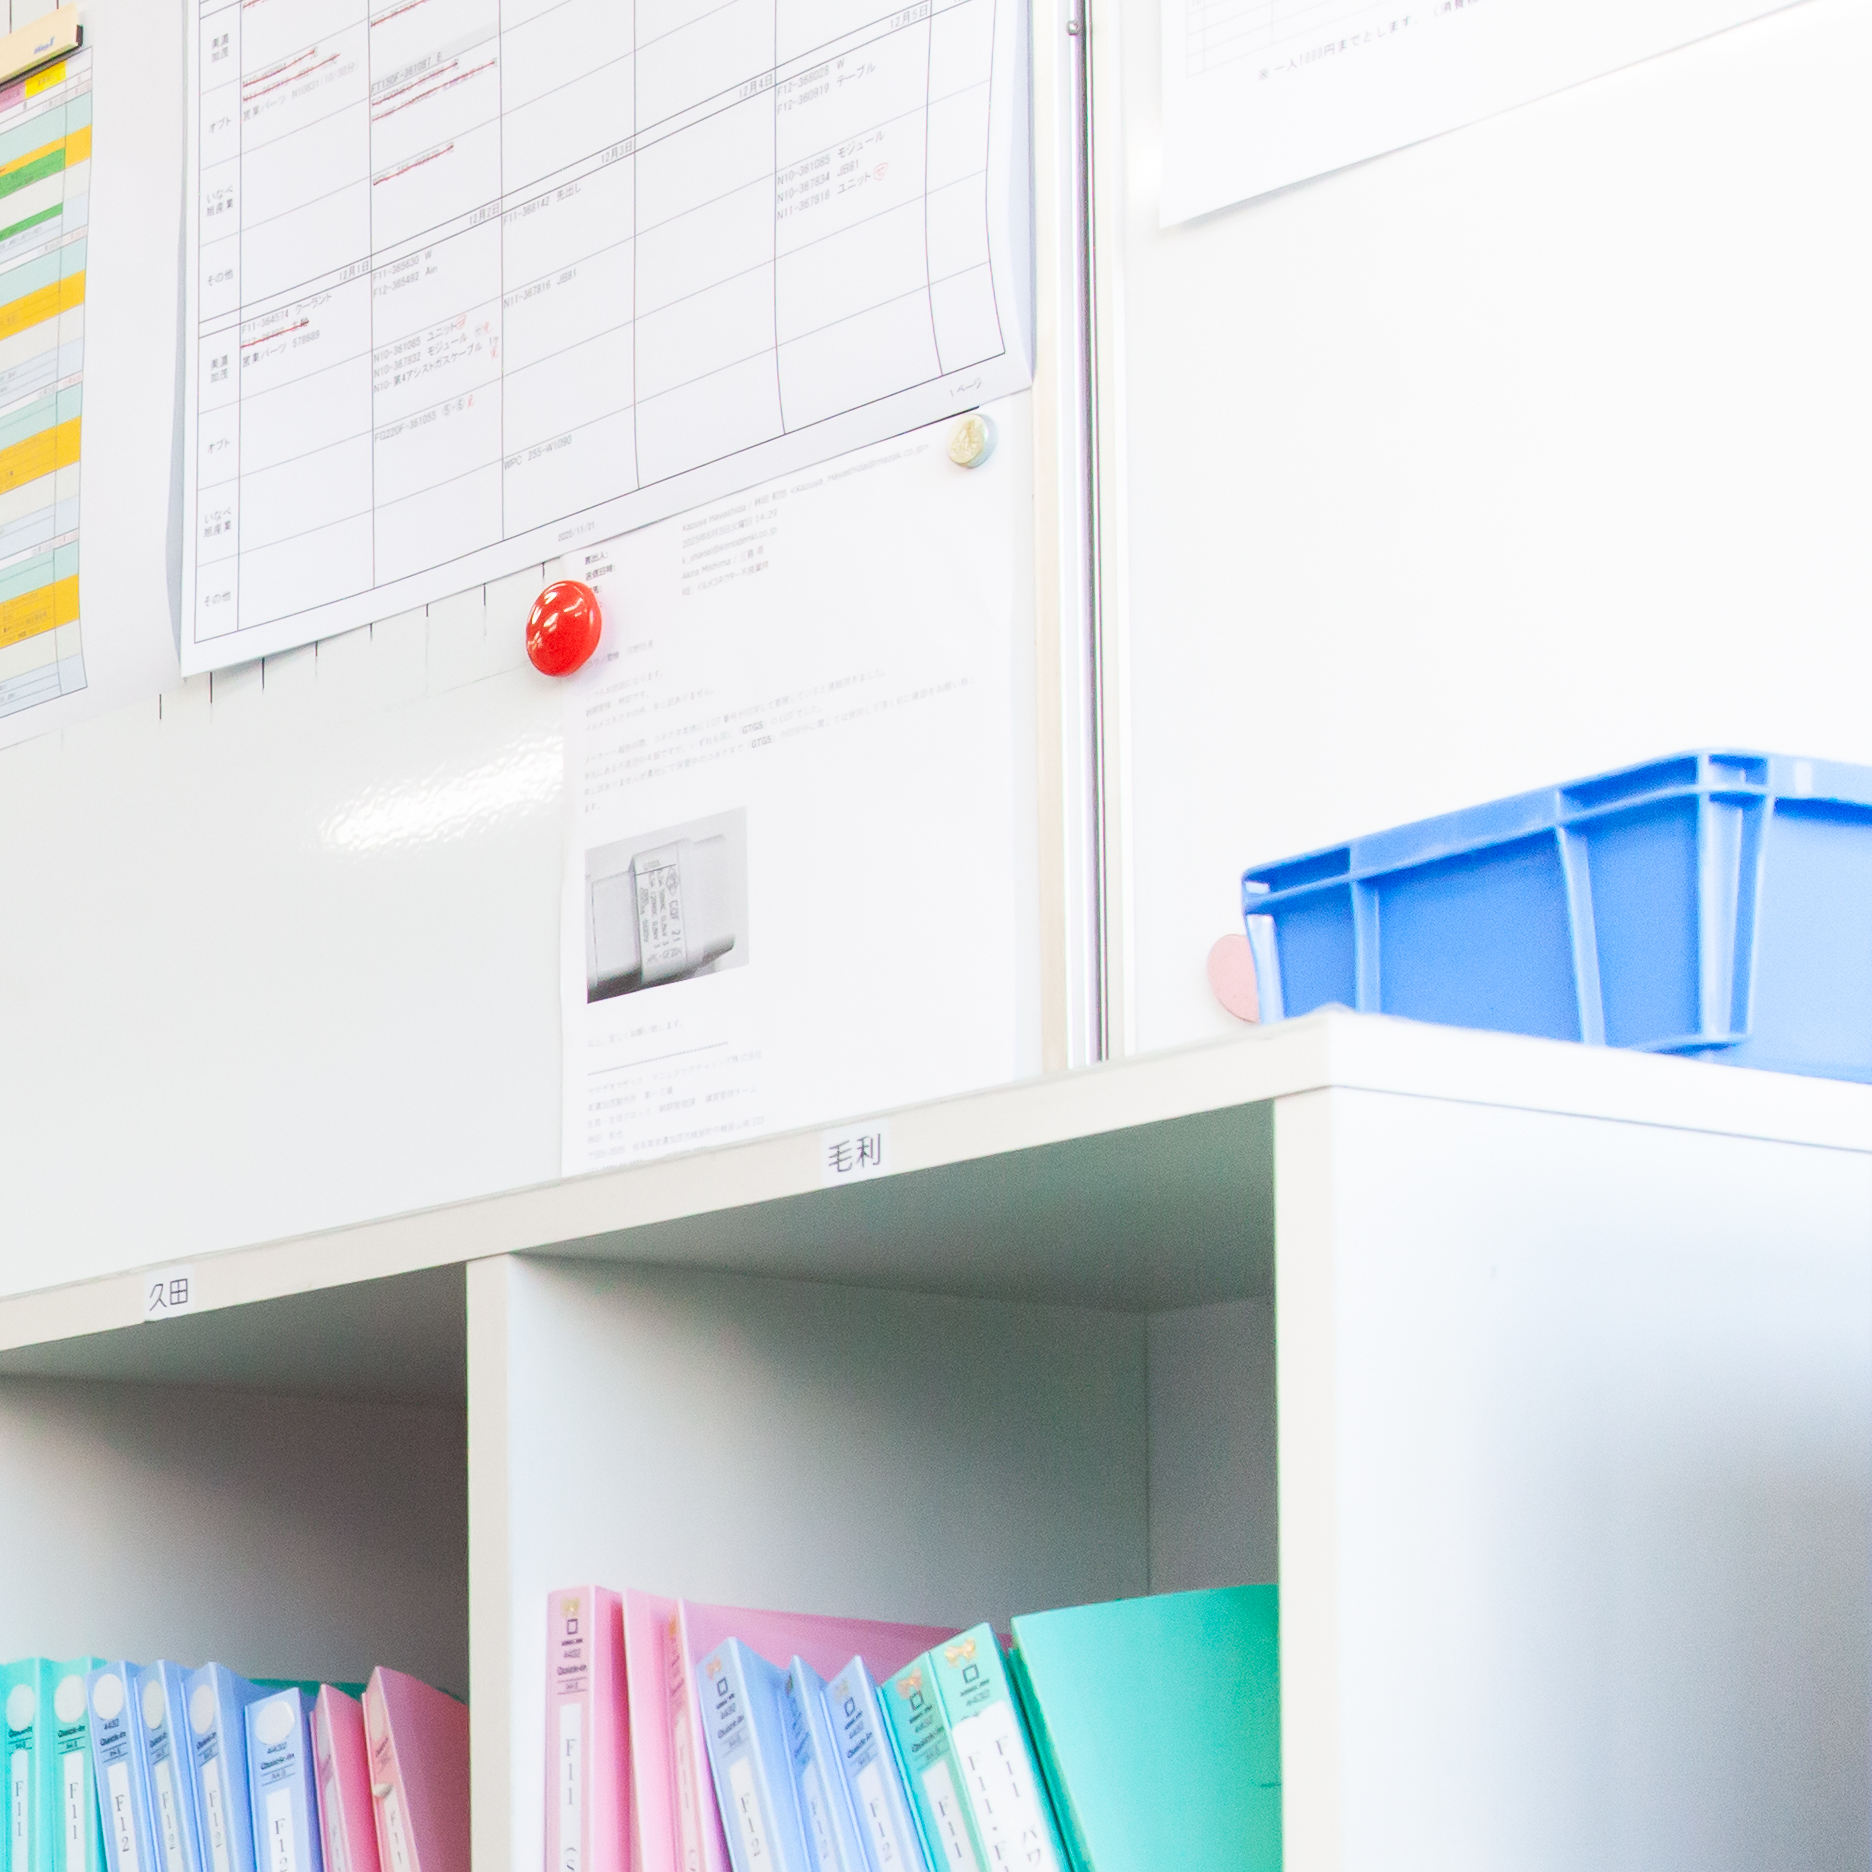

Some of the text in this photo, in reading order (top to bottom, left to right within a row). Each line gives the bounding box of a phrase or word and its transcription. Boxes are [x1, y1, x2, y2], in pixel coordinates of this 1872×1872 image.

[835, 58, 847, 71] W
[836, 61, 877, 89] テーブル
[738, 73, 774, 99] 12月4日
[601, 140, 633, 164] 12月3日
[836, 130, 886, 160] モジュール
[836, 171, 872, 196] ユニット
[467, 201, 500, 226] 12月2日
[206, 267, 235, 287] その他
[338, 260, 371, 282] 12月1日
[202, 590, 232, 609] その他
[827, 1132, 882, 1174] 毛利
[149, 1277, 190, 1312] 久田
[564, 1737, 579, 1806] F11
[114, 1793, 131, 1854] F12
